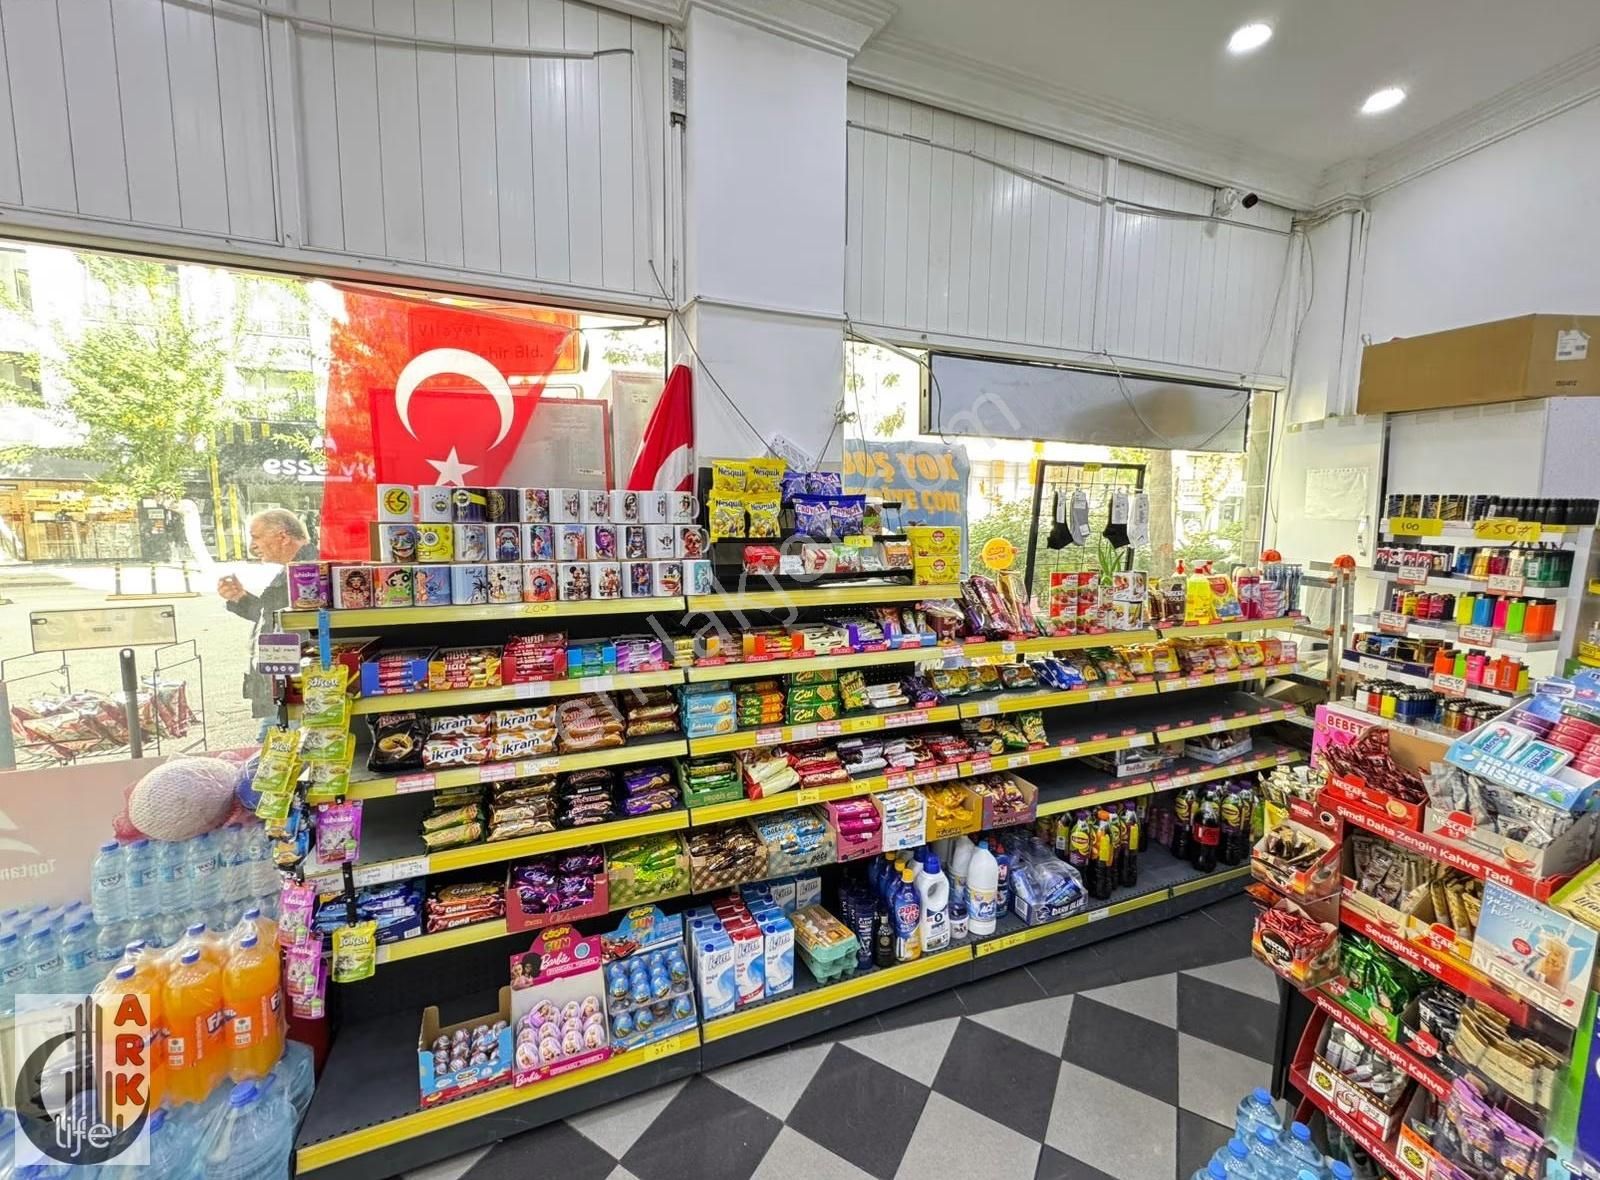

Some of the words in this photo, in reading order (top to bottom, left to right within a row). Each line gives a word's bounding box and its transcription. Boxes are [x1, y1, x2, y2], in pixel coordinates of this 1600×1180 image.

[433, 718, 473, 732] ikram
[500, 712, 538, 728] ikram
[431, 744, 473, 761] ikram
[502, 737, 541, 755] ikram
[1337, 804, 1366, 824] Şimdi
[1366, 816, 1396, 838] Daha
[1396, 830, 1438, 855] Zengin
[1438, 848, 1481, 874] Kahve
[1483, 864, 1514, 887] Tadı
[1364, 923, 1420, 961] Sevdiğiniz
[1420, 954, 1442, 974] Tat
[540, 952, 571, 971] Barbie
[1343, 1014, 1370, 1040] Daha
[1370, 1034, 1408, 1067] Zengin
[1408, 1062, 1446, 1096] Kahve
[515, 1072, 543, 1088] Barbie
